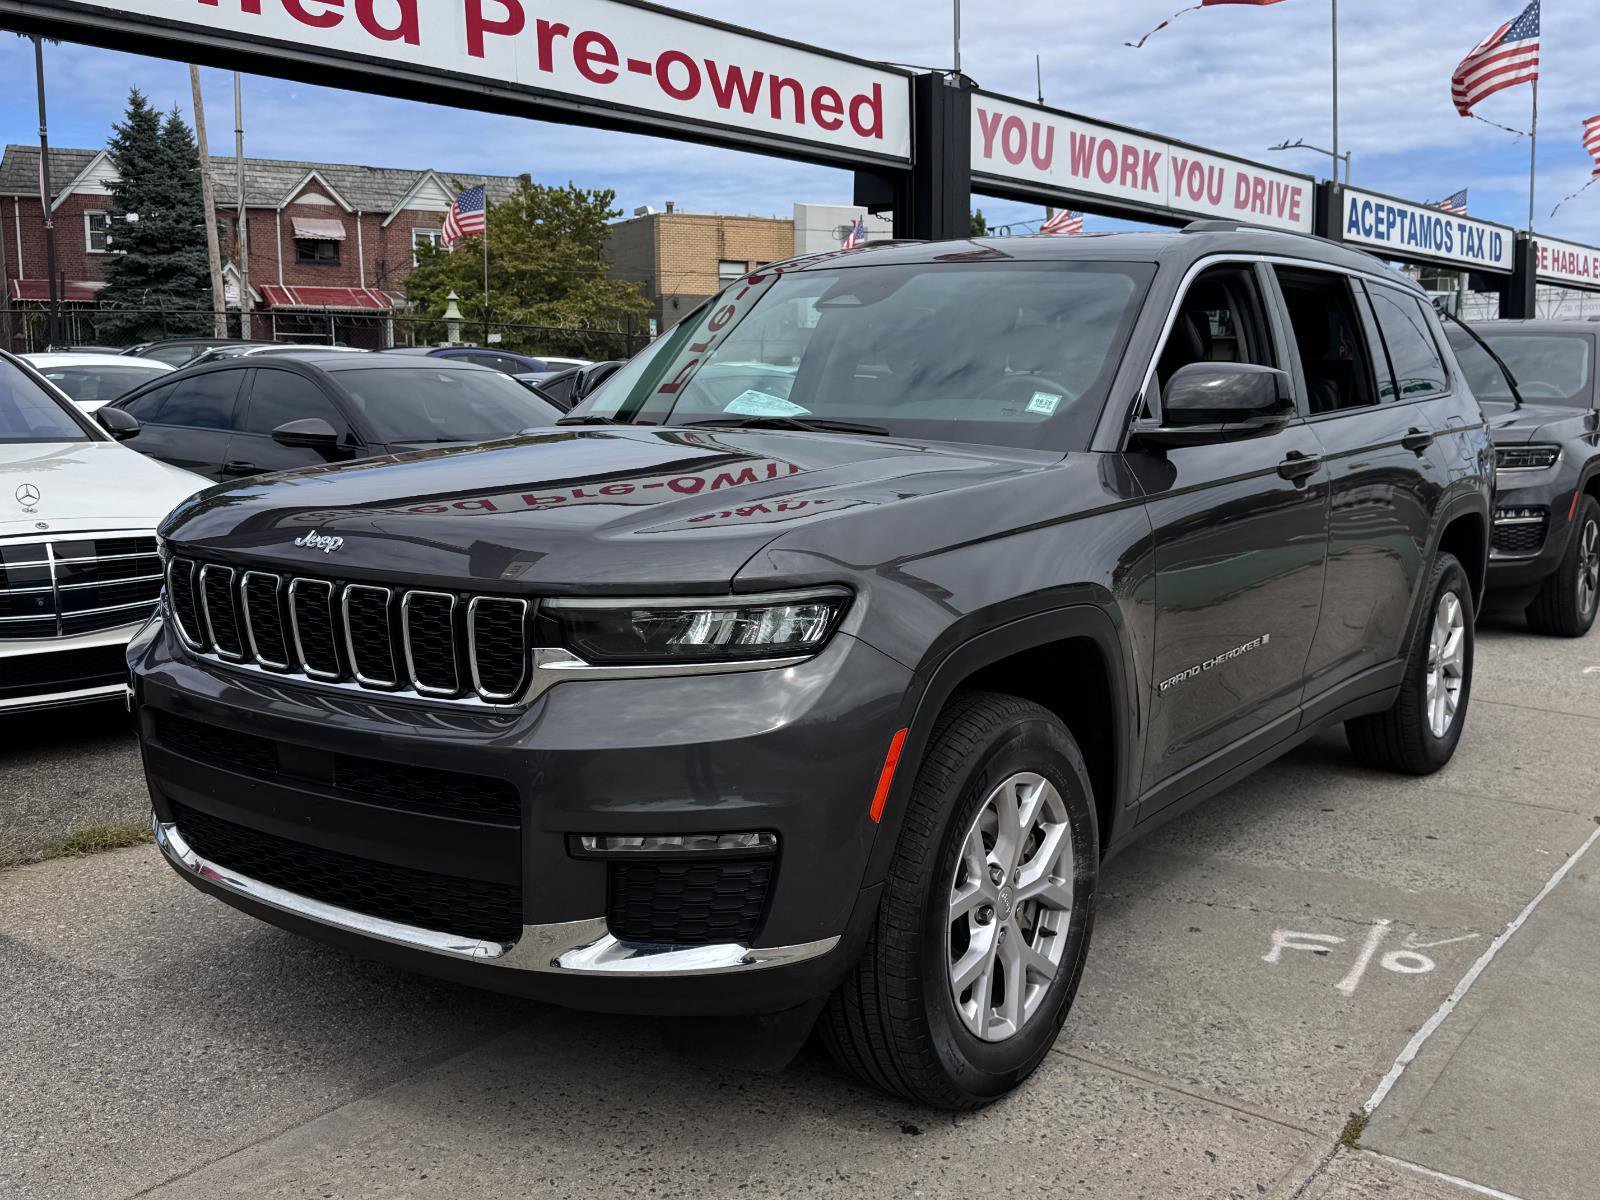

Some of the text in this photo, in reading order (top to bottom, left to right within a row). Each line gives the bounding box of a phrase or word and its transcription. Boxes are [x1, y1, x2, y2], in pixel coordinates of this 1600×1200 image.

[464, 0, 883, 139] Pre-owned
[977, 108, 1302, 222] YOU WORK YOU DRIVE
[1347, 197, 1502, 262] ACEPTAMOS TAX ID
[1552, 248, 1590, 277] HABLA
[294, 530, 344, 553] Jeep
[1160, 638, 1261, 691] GRAND CHEROKEE
